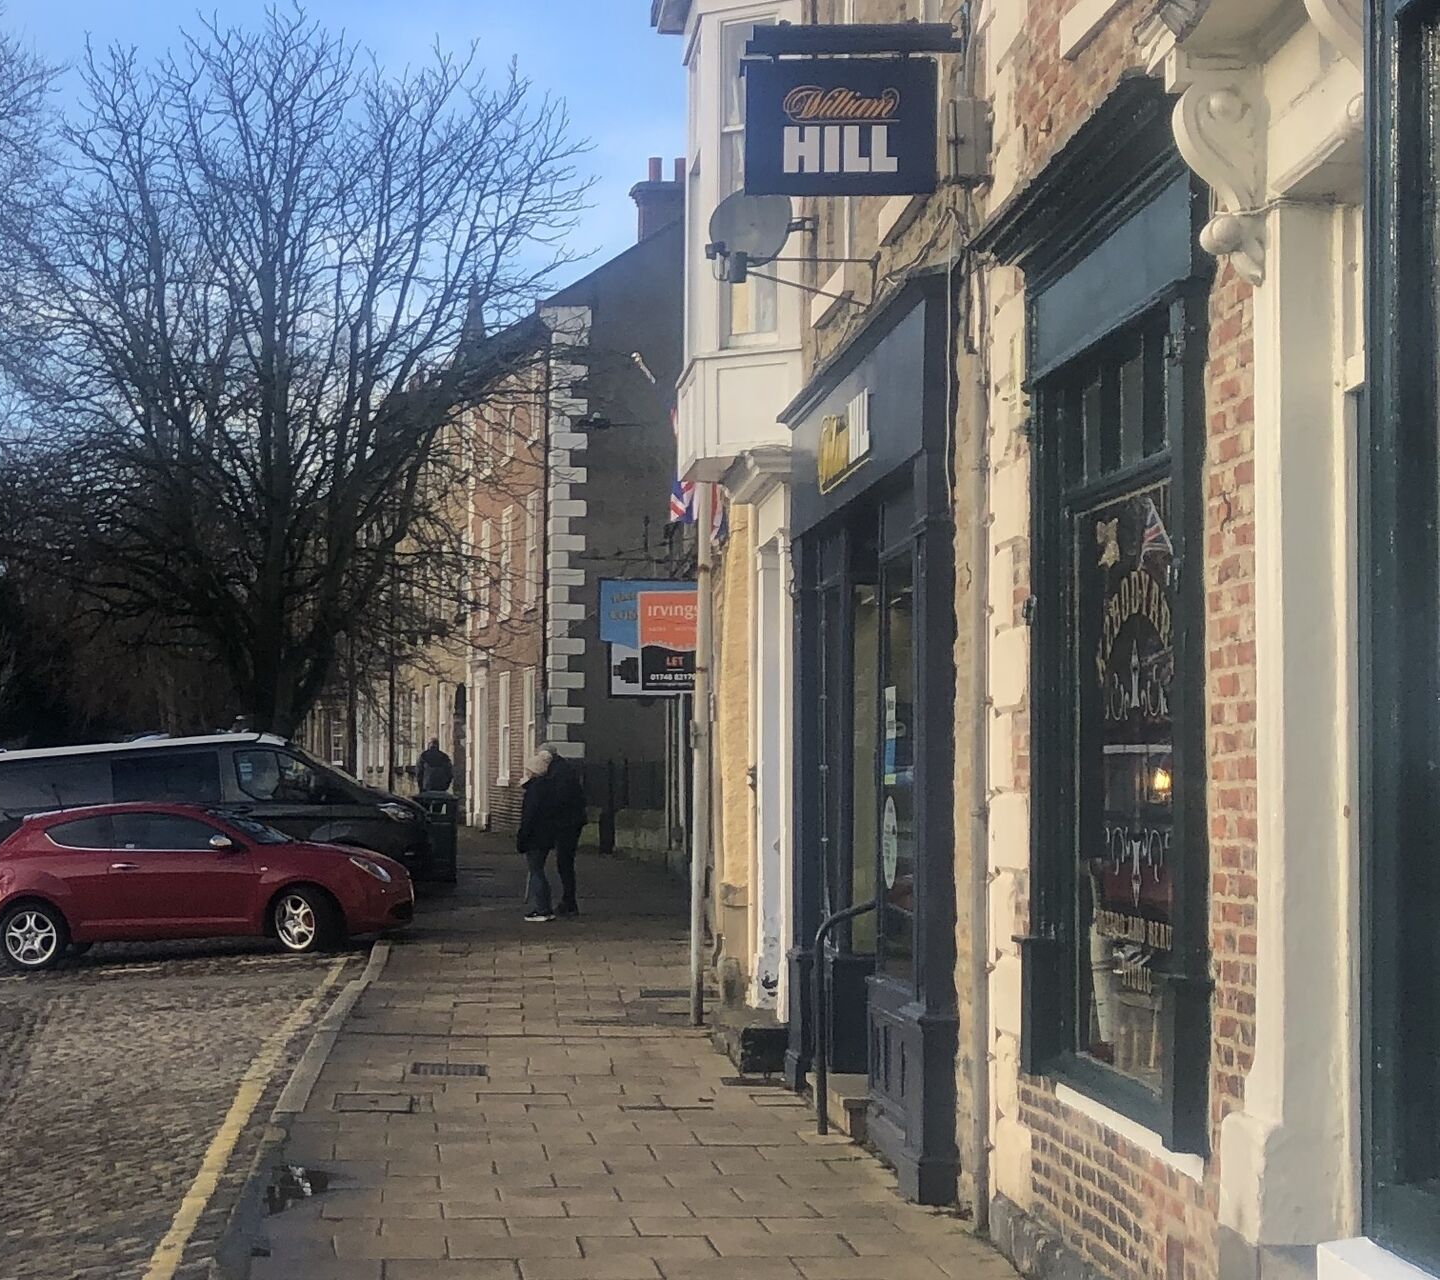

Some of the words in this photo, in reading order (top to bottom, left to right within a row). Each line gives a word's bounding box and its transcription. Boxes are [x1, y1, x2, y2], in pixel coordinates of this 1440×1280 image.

[782, 84, 901, 123] William
[783, 124, 899, 173] HILL
[666, 656, 684, 666] LET
